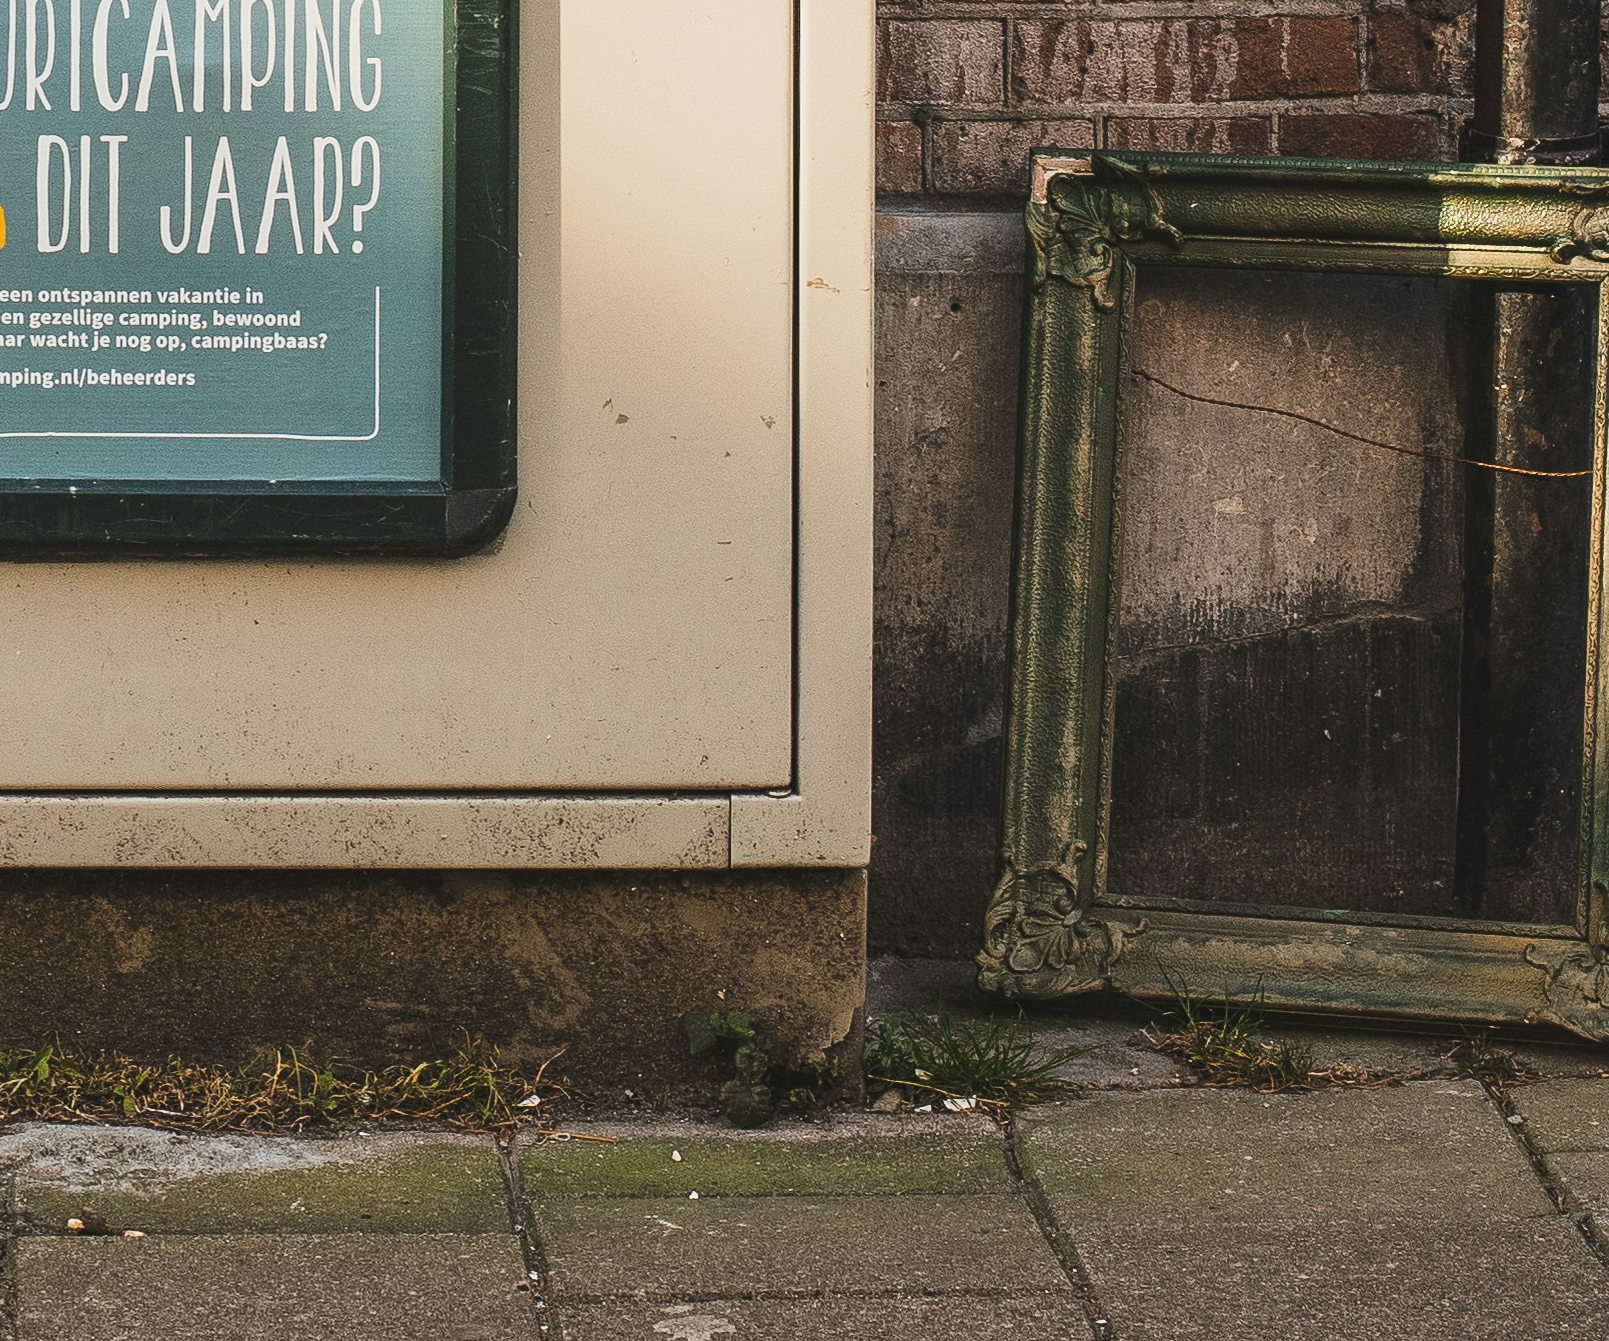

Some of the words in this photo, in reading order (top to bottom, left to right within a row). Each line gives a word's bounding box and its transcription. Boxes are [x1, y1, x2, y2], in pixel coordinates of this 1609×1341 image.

[37, 134, 129, 254] DIT
[160, 135, 381, 255] JAAR?
[38, 290, 152, 307] ontspannen
[157, 288, 241, 304] vakantie
[245, 288, 264, 304] in
[29, 309, 114, 329] gezellige
[118, 310, 207, 330] camping,
[213, 310, 301, 327] bewoond
[29, 332, 89, 348] wacht
[91, 332, 111, 351] je
[115, 336, 151, 351] nog
[156, 336, 186, 352] op,
[191, 332, 328, 353] campingbaas?
